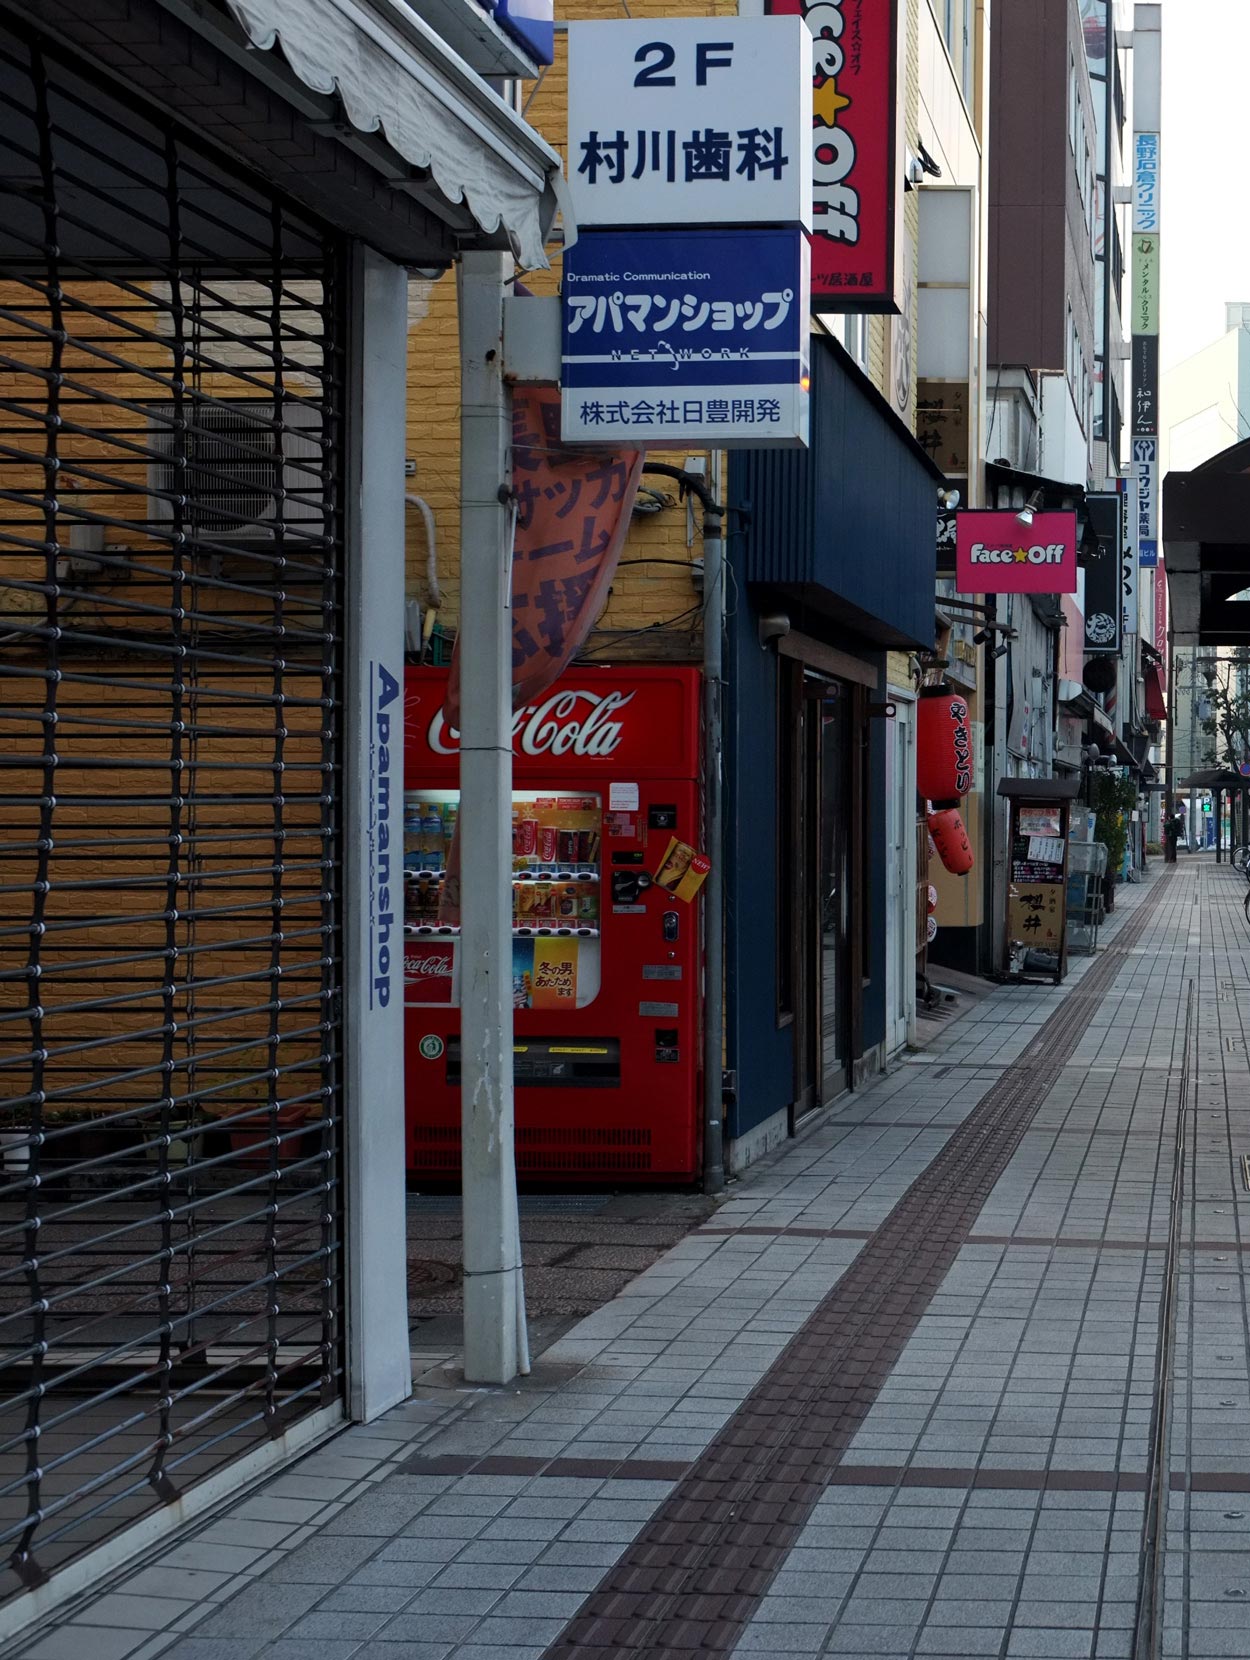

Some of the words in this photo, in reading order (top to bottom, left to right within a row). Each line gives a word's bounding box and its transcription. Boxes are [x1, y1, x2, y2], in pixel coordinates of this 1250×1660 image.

[634, 41, 734, 88] 2F
[578, 127, 789, 185] 村川歯科
[567, 272, 620, 282] Dramatic
[623, 270, 711, 282] Communication
[811, 272, 873, 287] ツ居酒屋
[567, 288, 793, 334] アパマンショップ
[580, 399, 781, 426] 株式会社日豊開発
[950, 702, 971, 793] やきとり
[374, 662, 400, 1008] Apamanshop
